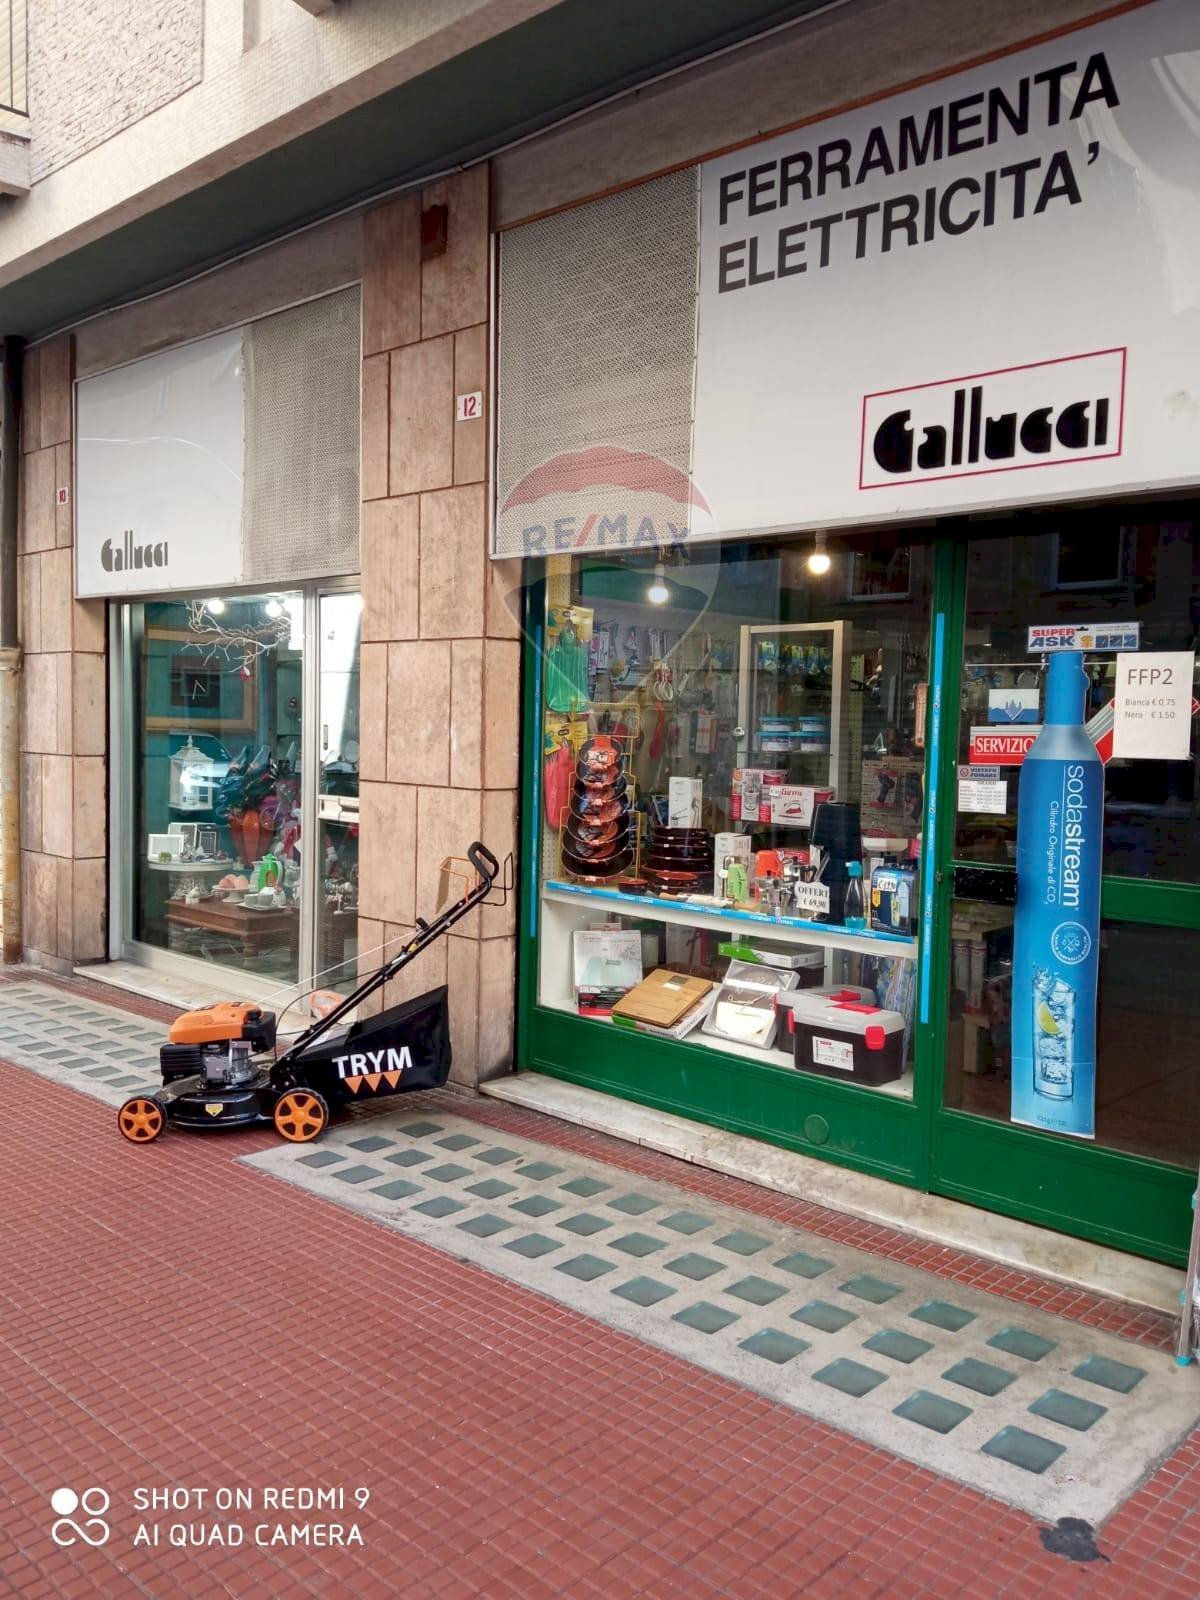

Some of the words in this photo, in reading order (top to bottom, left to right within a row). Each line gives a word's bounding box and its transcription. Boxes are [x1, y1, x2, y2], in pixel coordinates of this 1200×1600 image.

[718, 51, 1121, 226] FERRAMENTA
[463, 395, 477, 417] 12
[873, 385, 1110, 474] Gallucci
[59, 489, 66, 503] 10
[101, 530, 168, 572] Gallucci
[1030, 636, 1074, 648] ASK
[1031, 628, 1075, 637] SUPER
[1127, 668, 1173, 685] FFP2
[1125, 698, 1150, 706] Bianca
[1124, 711, 1143, 719] Nera
[1050, 800, 1059, 834] Cilindro
[1063, 764, 1087, 907] sodastream
[1047, 836, 1058, 873] Originale
[1048, 874, 1056, 884] di
[332, 1046, 413, 1079] TRYM
